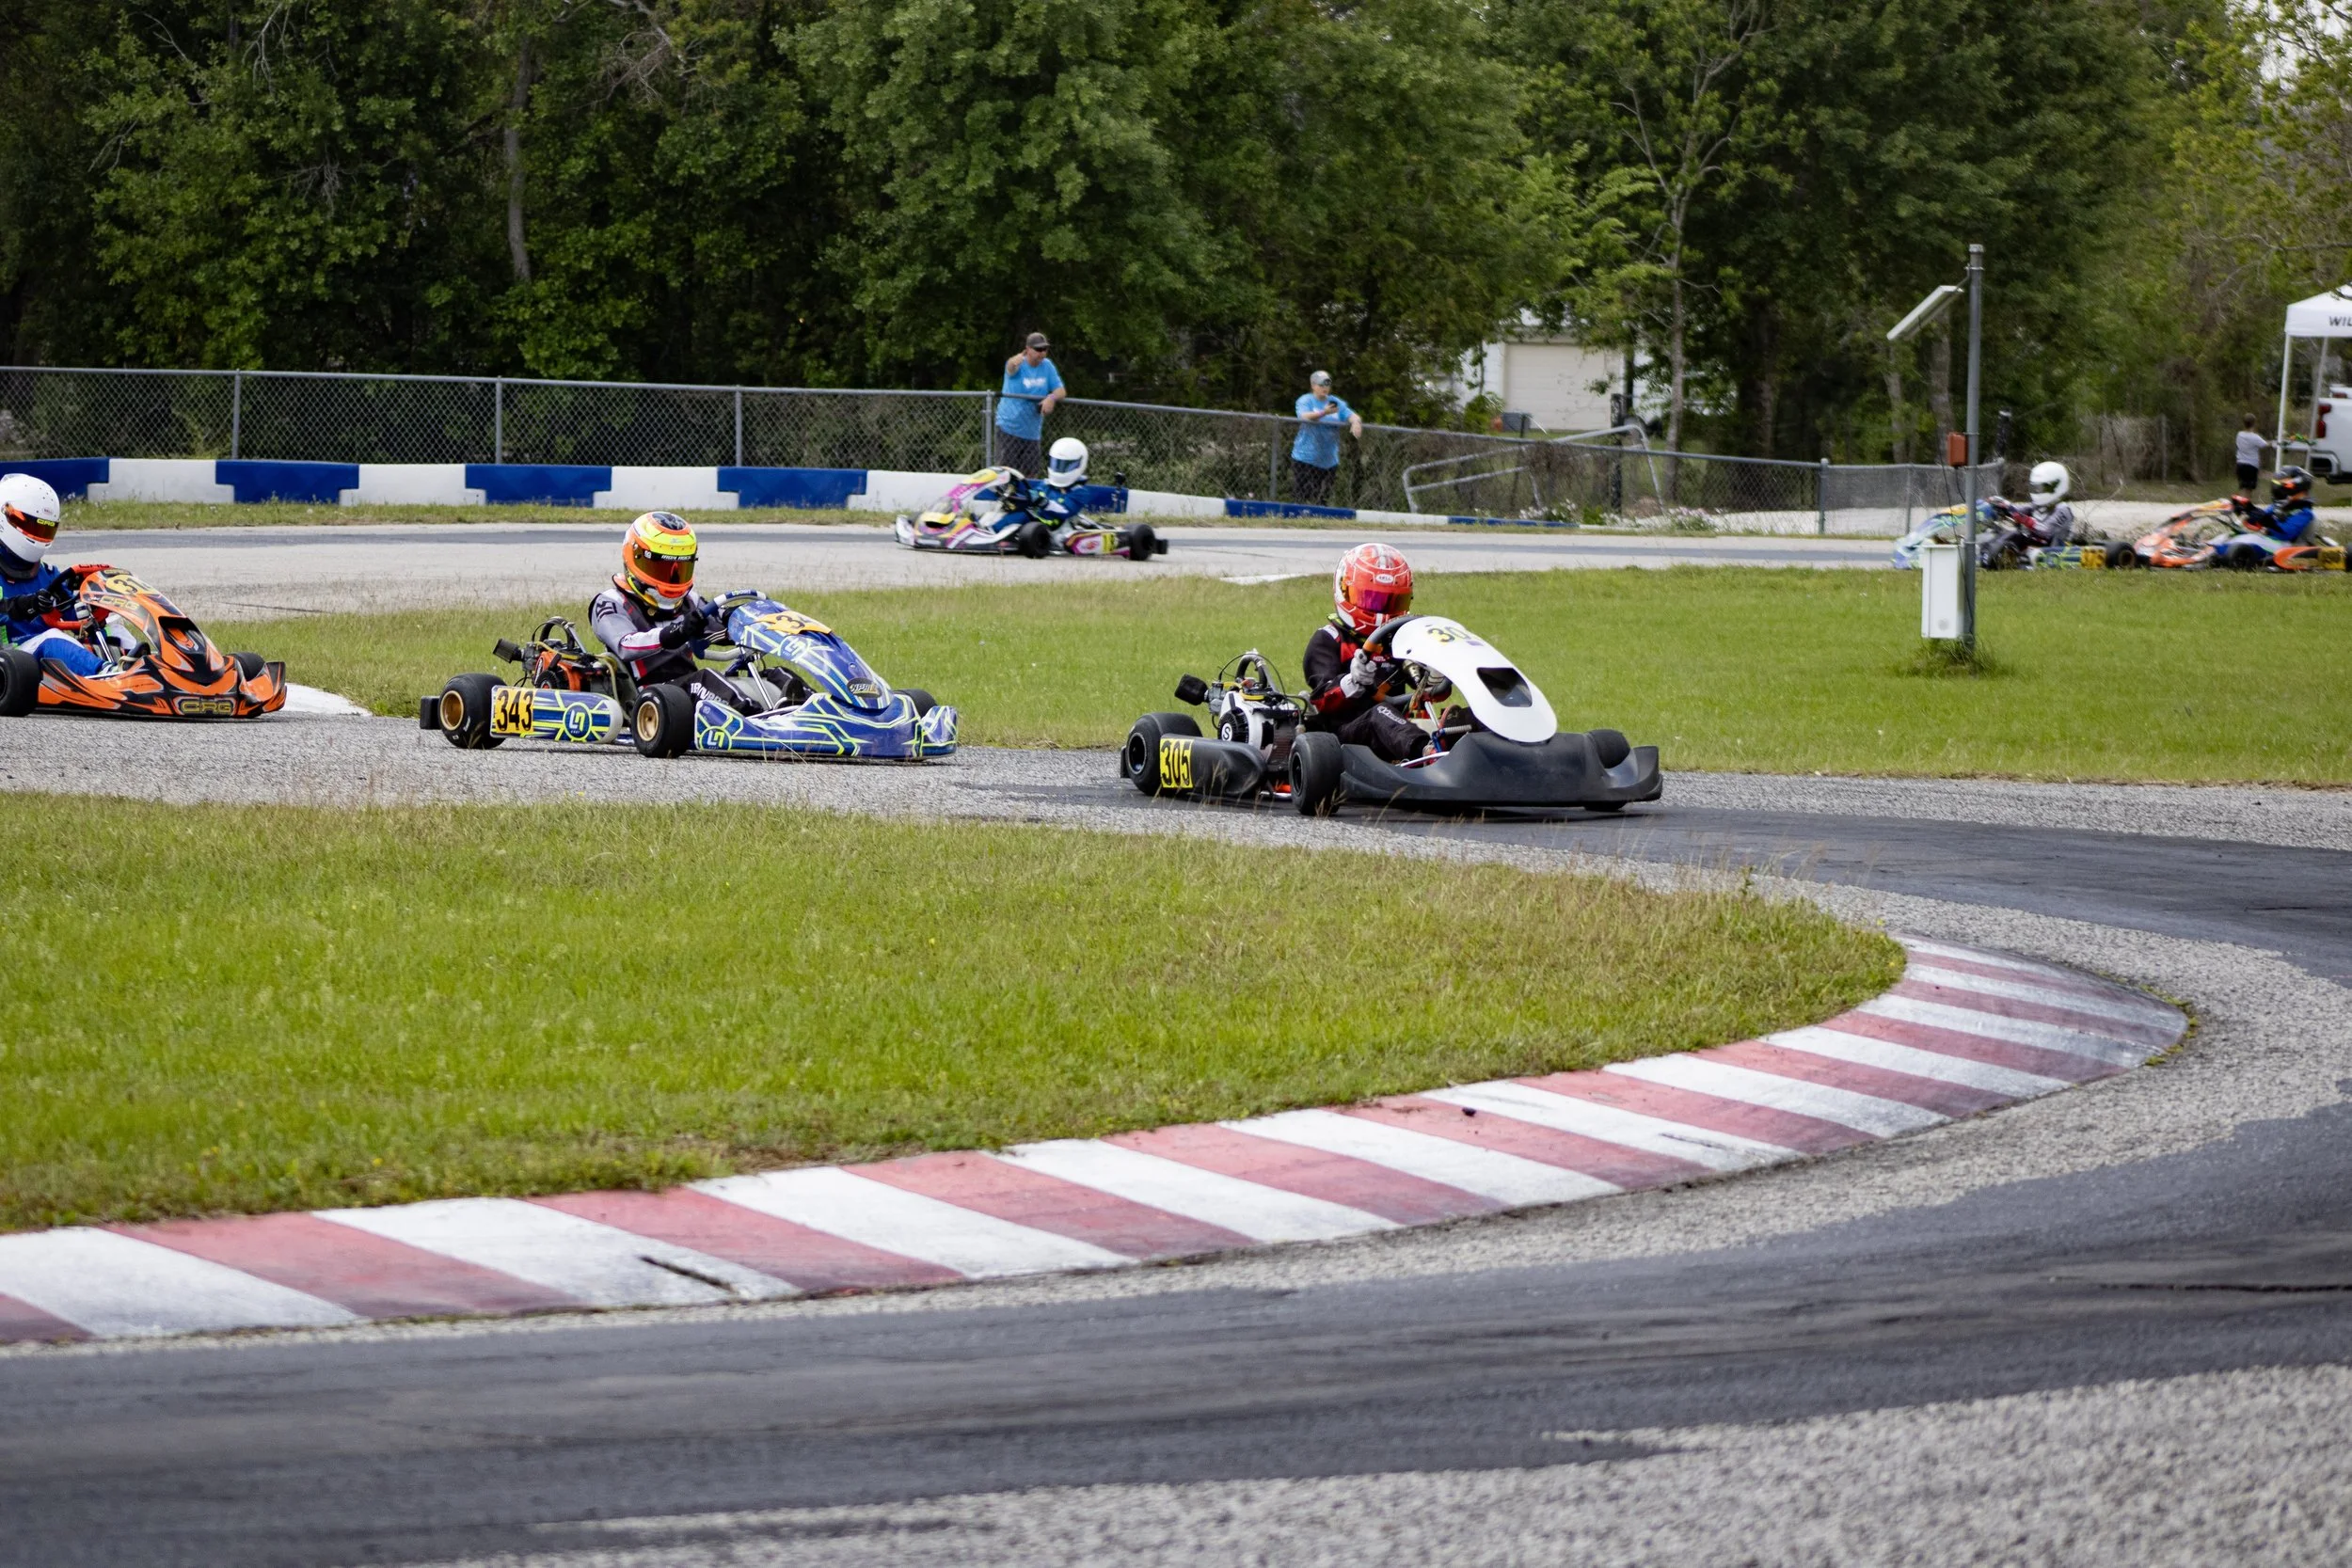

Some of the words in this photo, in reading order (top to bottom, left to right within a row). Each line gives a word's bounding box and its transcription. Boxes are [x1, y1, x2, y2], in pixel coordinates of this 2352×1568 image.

[182, 700, 232, 715] CRG
[496, 689, 533, 731] 343
[1161, 740, 1190, 785] 305
